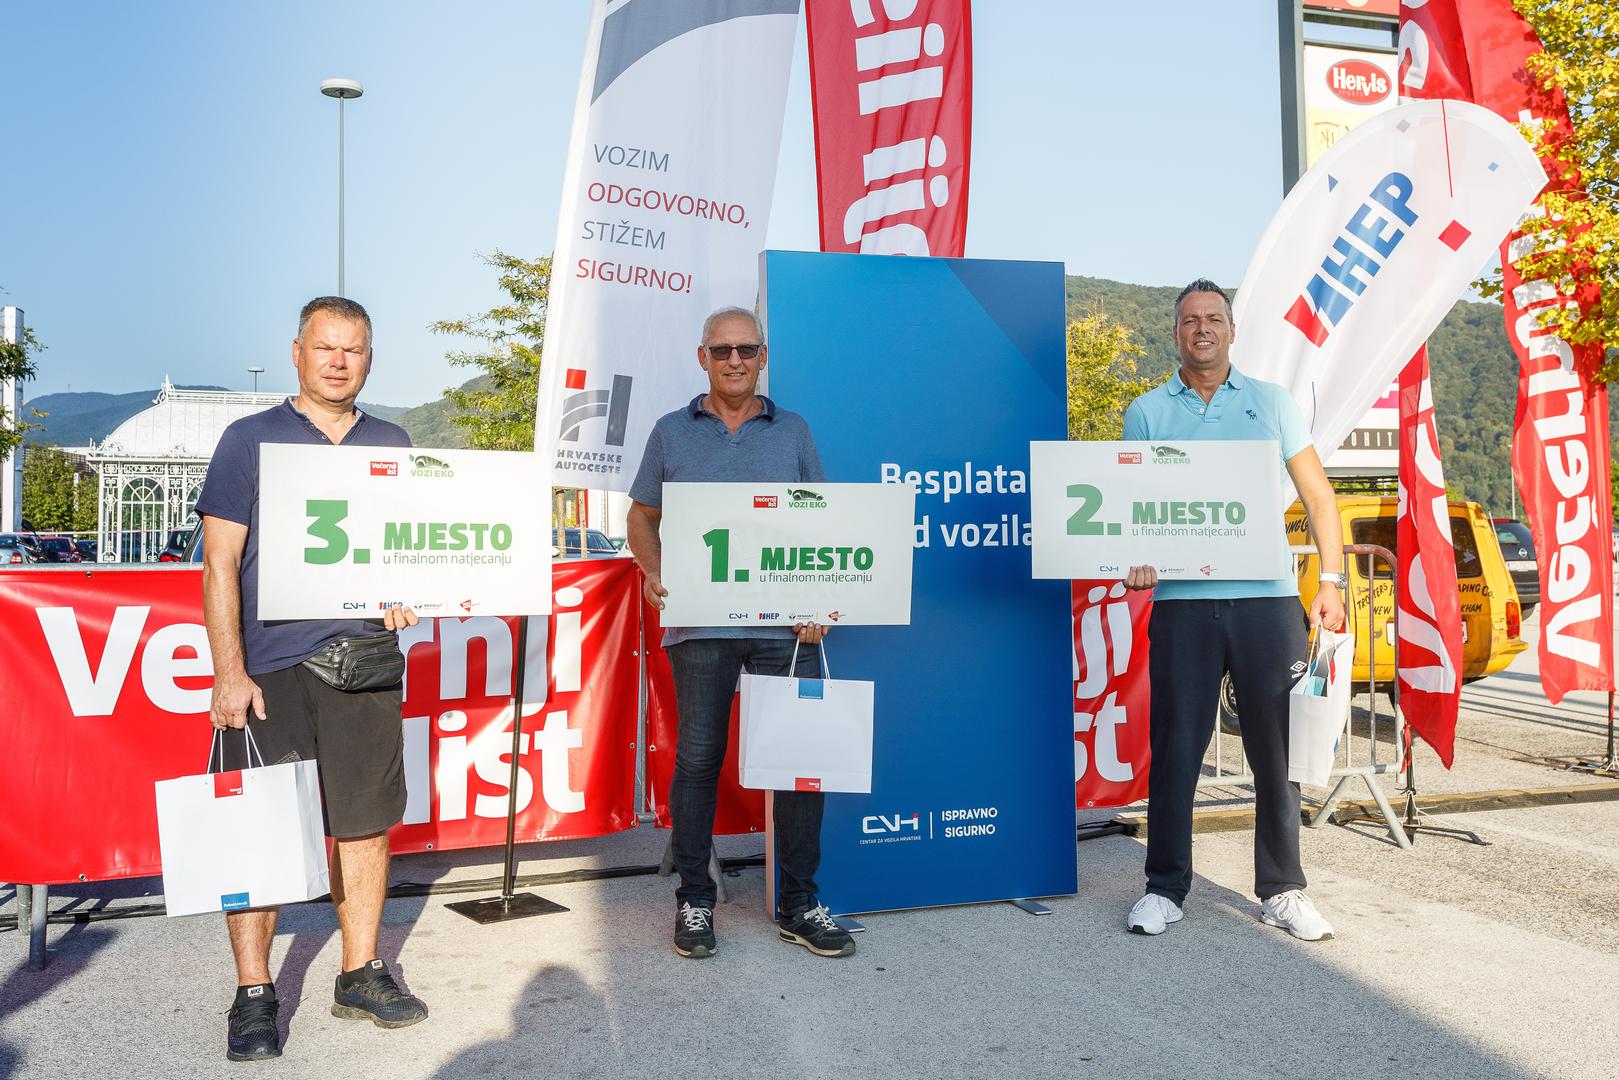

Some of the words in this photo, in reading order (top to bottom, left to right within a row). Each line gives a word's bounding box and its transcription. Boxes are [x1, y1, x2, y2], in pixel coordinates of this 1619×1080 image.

[1333, 67, 1387, 98] Hervis
[594, 143, 670, 173] VOZIM
[587, 182, 751, 229] ODGOVORNO,
[581, 219, 667, 251] STIŽEM
[1321, 172, 1419, 297] HEP
[576, 257, 693, 294] SIGURNO!
[555, 461, 621, 474] AUTOCESTE
[557, 449, 622, 463] HRVATSKE
[410, 469, 433, 477] VOZI
[434, 470, 454, 478] EKO
[1066, 485, 1122, 536] 2.
[1132, 501, 1246, 525] MJESTO
[304, 500, 370, 565] 3.
[384, 522, 513, 551] MJESTO
[1132, 529, 1138, 537] u
[1141, 527, 1188, 538] finalnom
[1190, 527, 1246, 540] natjecanju
[383, 556, 391, 564] u
[394, 553, 447, 565] finalnom
[450, 554, 512, 568] natjecanju
[702, 528, 750, 583] 1.
[760, 546, 874, 571] MJESTO
[760, 572, 767, 582] u
[769, 571, 815, 583] finalnom
[817, 571, 873, 585] natjecanju
[1357, 582, 1388, 611] TROTERS
[863, 812, 919, 834] CVH
[942, 807, 998, 821] ISPRAVNO
[900, 835, 922, 843] HRVATSKE
[945, 823, 996, 838] SIGURNO
